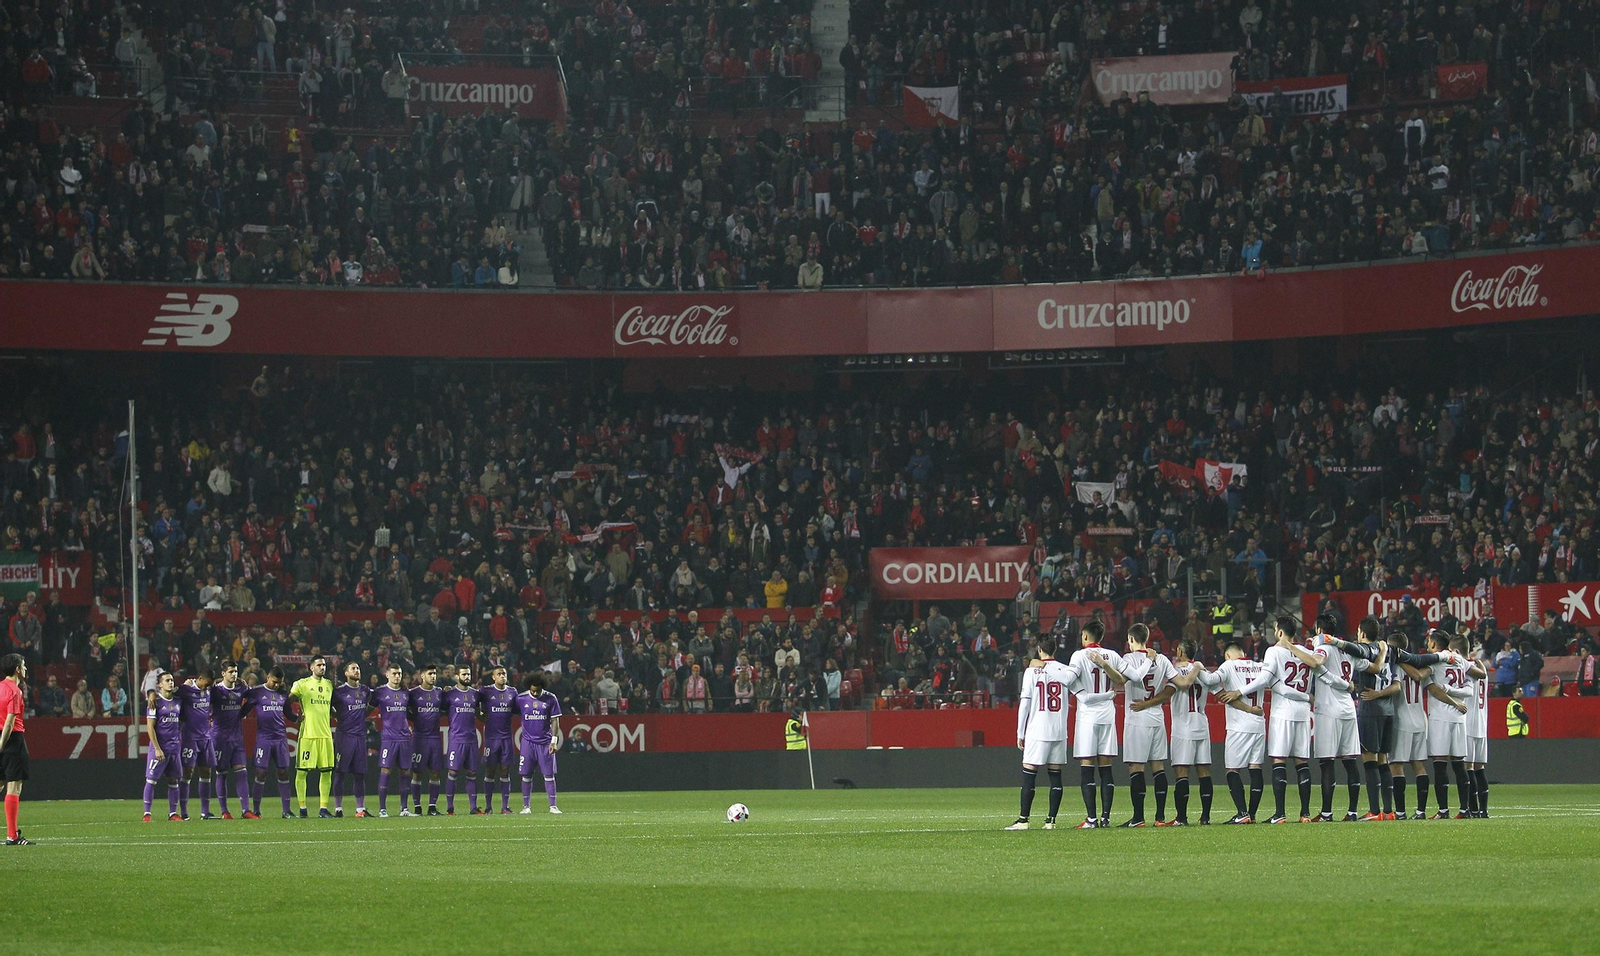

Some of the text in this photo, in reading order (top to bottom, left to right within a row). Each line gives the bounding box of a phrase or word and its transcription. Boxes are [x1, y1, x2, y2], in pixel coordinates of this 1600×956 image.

[408, 77, 534, 108] Cruzcampo
[1094, 69, 1222, 96] Cruzcampo
[1450, 264, 1544, 313] Coca-Cola
[614, 304, 735, 346] Coca-Cola
[1037, 298, 1191, 332] Cruzcampo
[882, 561, 1028, 584] CORDIALITY
[1367, 592, 1486, 623] Crcampo
[1284, 661, 1310, 692] 23
[1340, 661, 1352, 683] 8
[1036, 681, 1062, 712] 18
[1142, 674, 1155, 702] 5
[149, 759, 159, 770] 17
[182, 748, 194, 758] 23
[256, 748, 264, 758] 14
[302, 751, 310, 760] 13
[382, 748, 388, 758] 8
[412, 753, 422, 763] 20
[449, 751, 455, 760] 6
